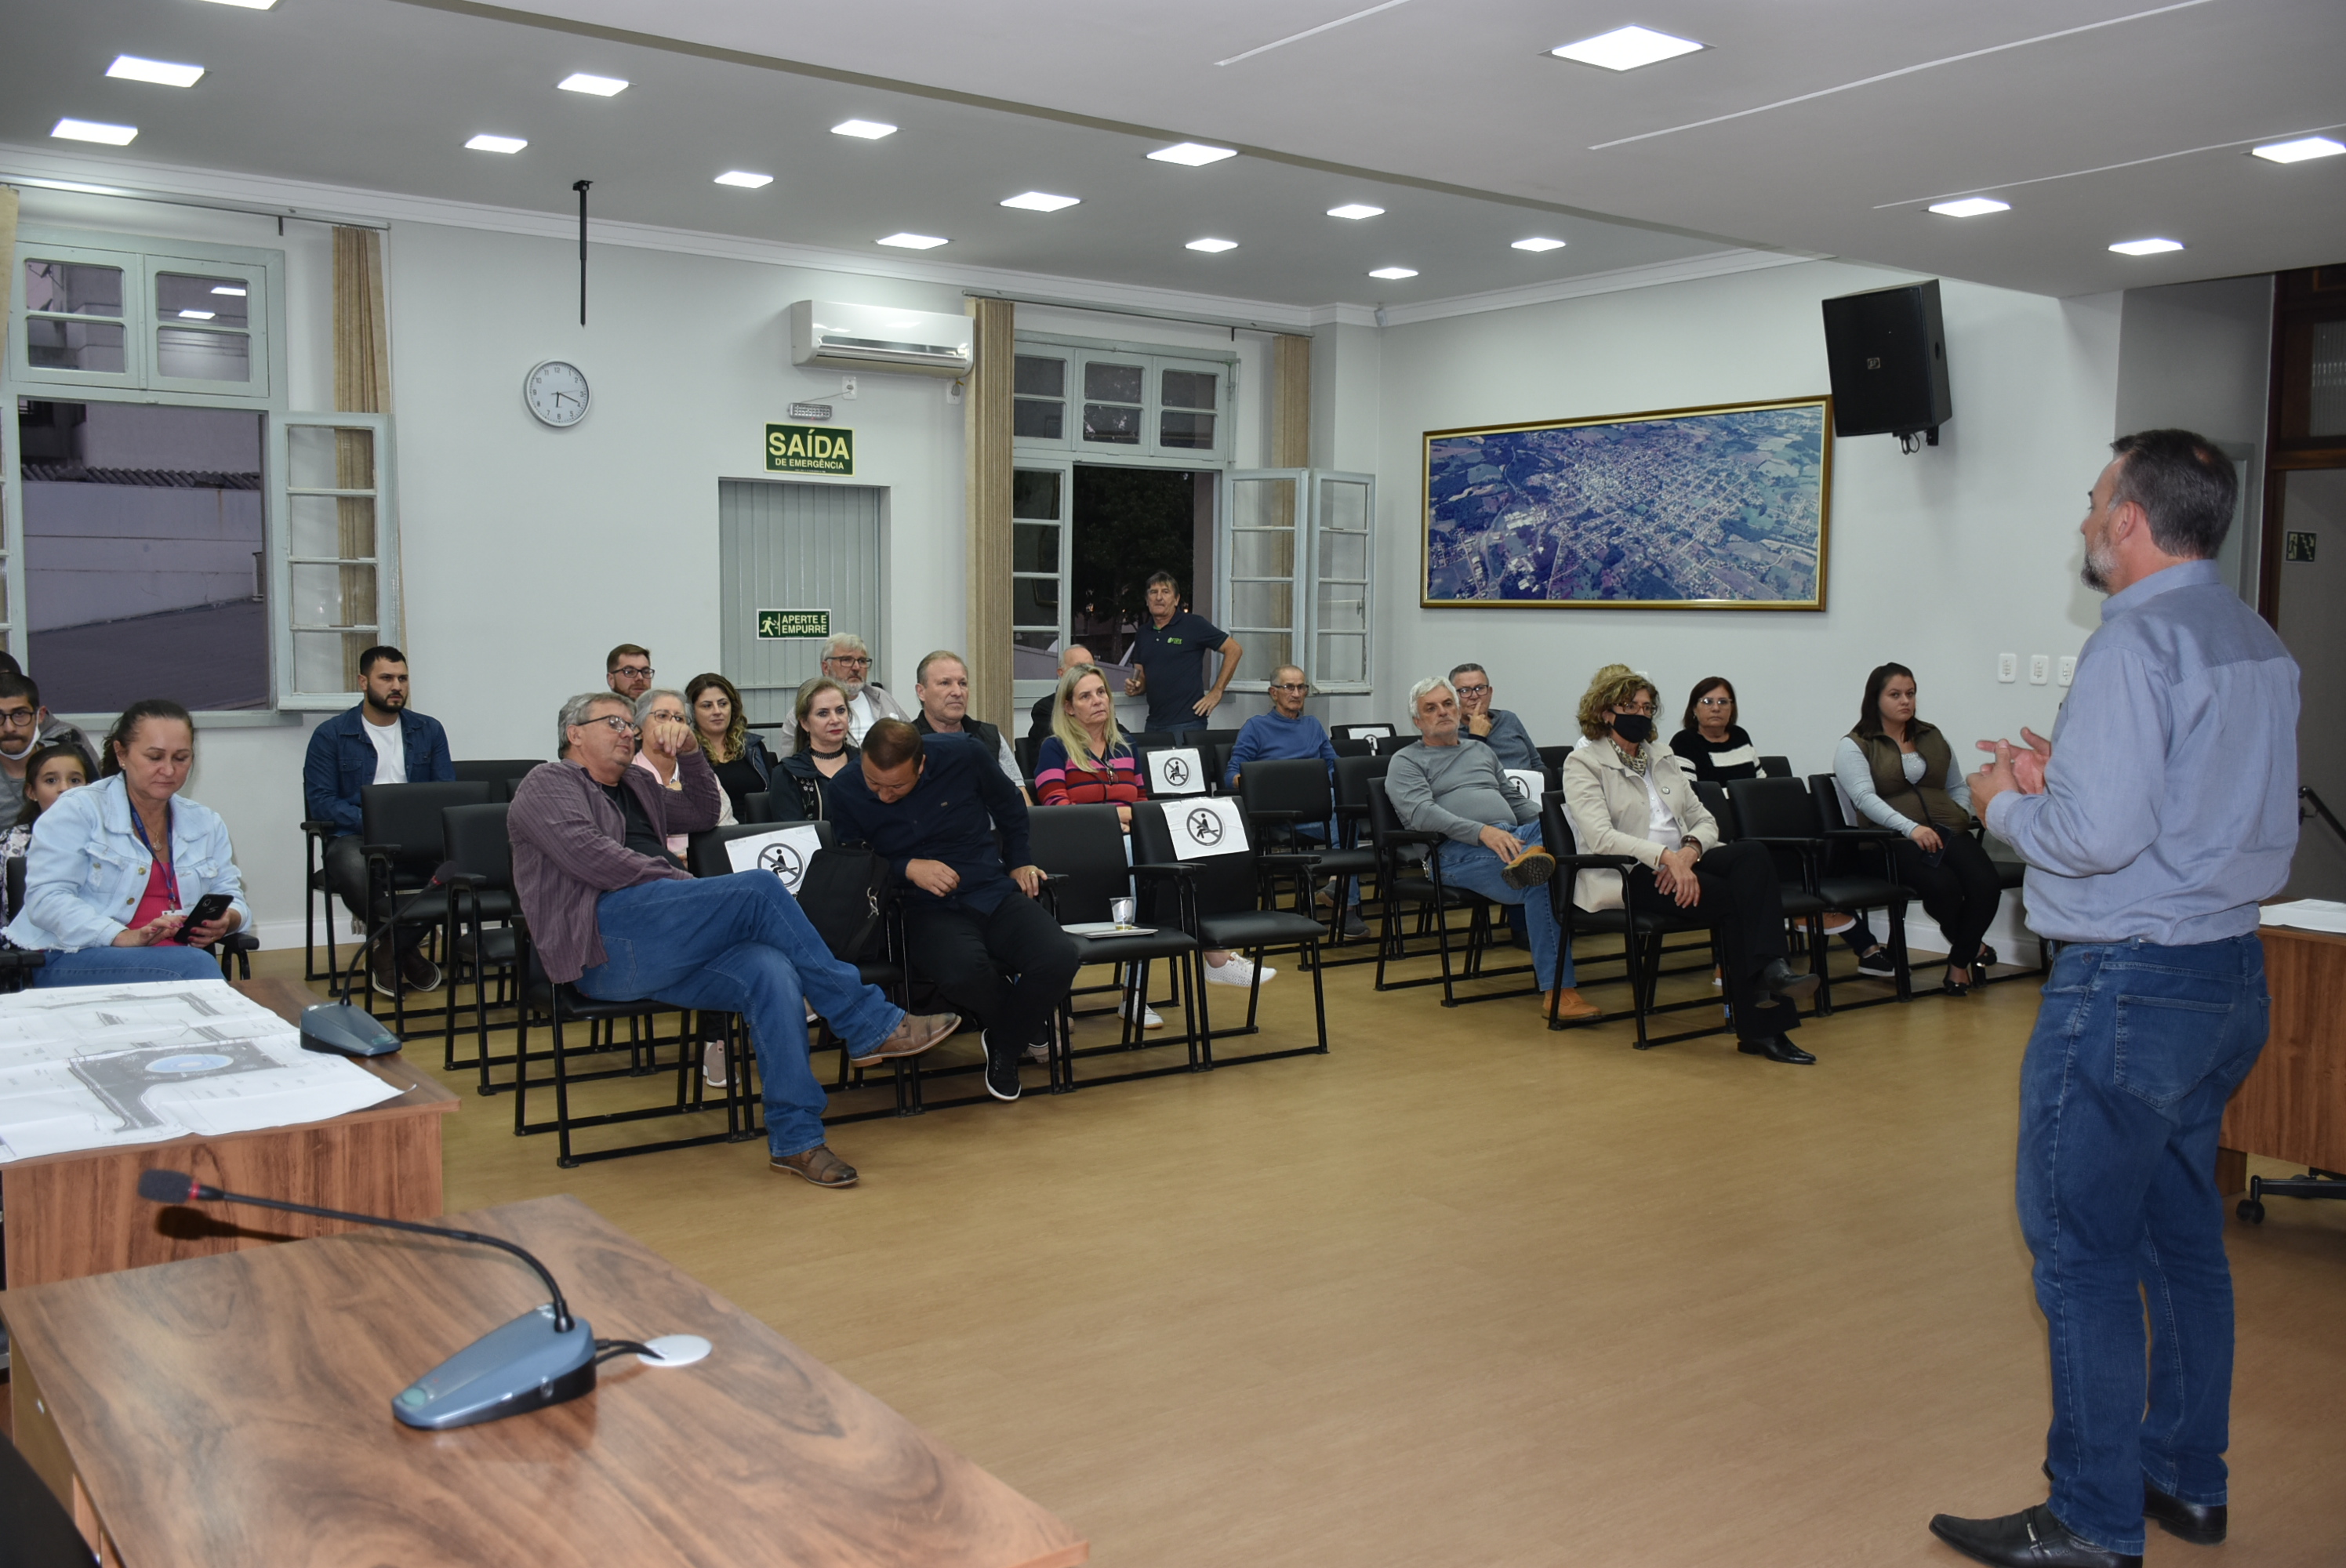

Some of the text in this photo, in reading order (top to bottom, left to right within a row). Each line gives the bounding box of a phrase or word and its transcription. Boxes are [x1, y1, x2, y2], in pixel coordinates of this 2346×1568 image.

[769, 429, 850, 459] SAÍDA
[775, 458, 844, 470] DE EMERGÊNCIA
[782, 615, 827, 624] APERTE E
[782, 625, 827, 633] EMPURRE
